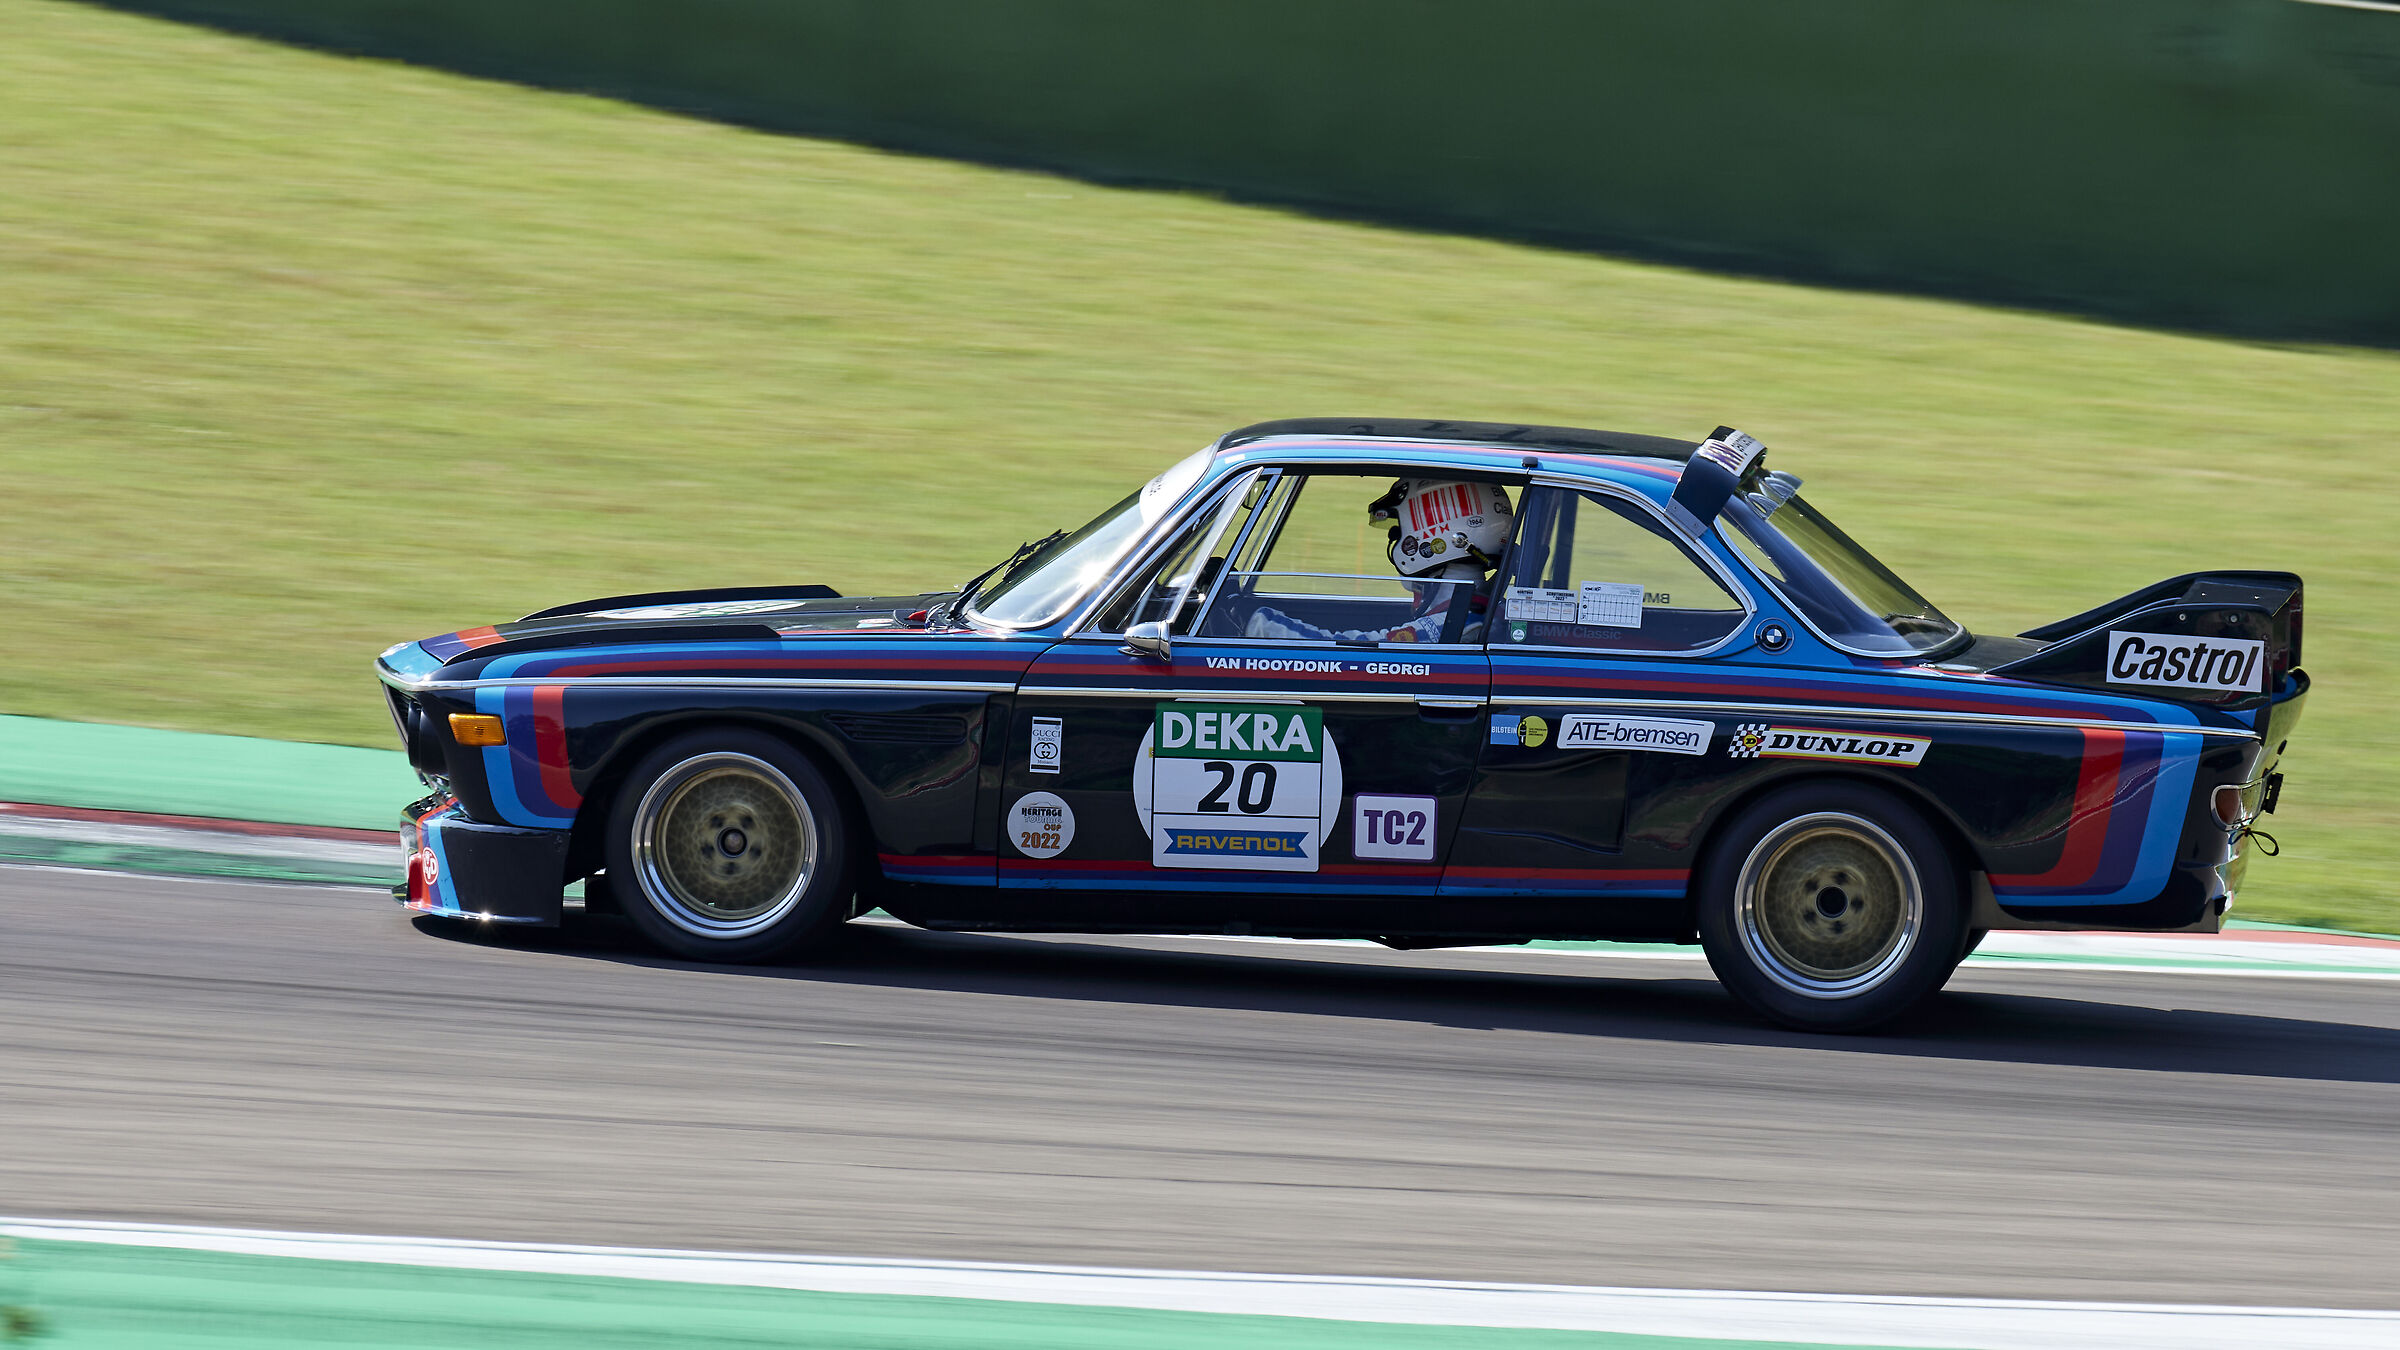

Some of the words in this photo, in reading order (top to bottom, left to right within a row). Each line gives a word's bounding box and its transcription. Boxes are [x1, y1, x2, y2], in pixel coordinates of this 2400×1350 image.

[1469, 518, 1483, 526] 1964
[1533, 624, 1571, 638] BMW
[1572, 627, 1622, 640] Classic
[1206, 657, 1241, 670] VAN
[1245, 658, 1342, 673] HOOYDONK
[1365, 662, 1431, 676] GEORGI
[2112, 636, 2260, 686] Castrol
[1032, 729, 1061, 738] GUCCI
[1162, 711, 1314, 753] DEKRA
[1491, 725, 1518, 734] BILSTEIN
[1567, 721, 1700, 747] ATE-bremsen
[1768, 733, 1915, 757] DUNLOP
[1197, 761, 1278, 814] 20
[1021, 807, 1062, 817] HERITAGE
[1023, 815, 1062, 824] TOURING
[1043, 823, 1062, 831] CUP
[1363, 809, 1427, 845] TC2
[1021, 832, 1060, 849] 2022
[1177, 835, 1296, 852] RAVENOL
